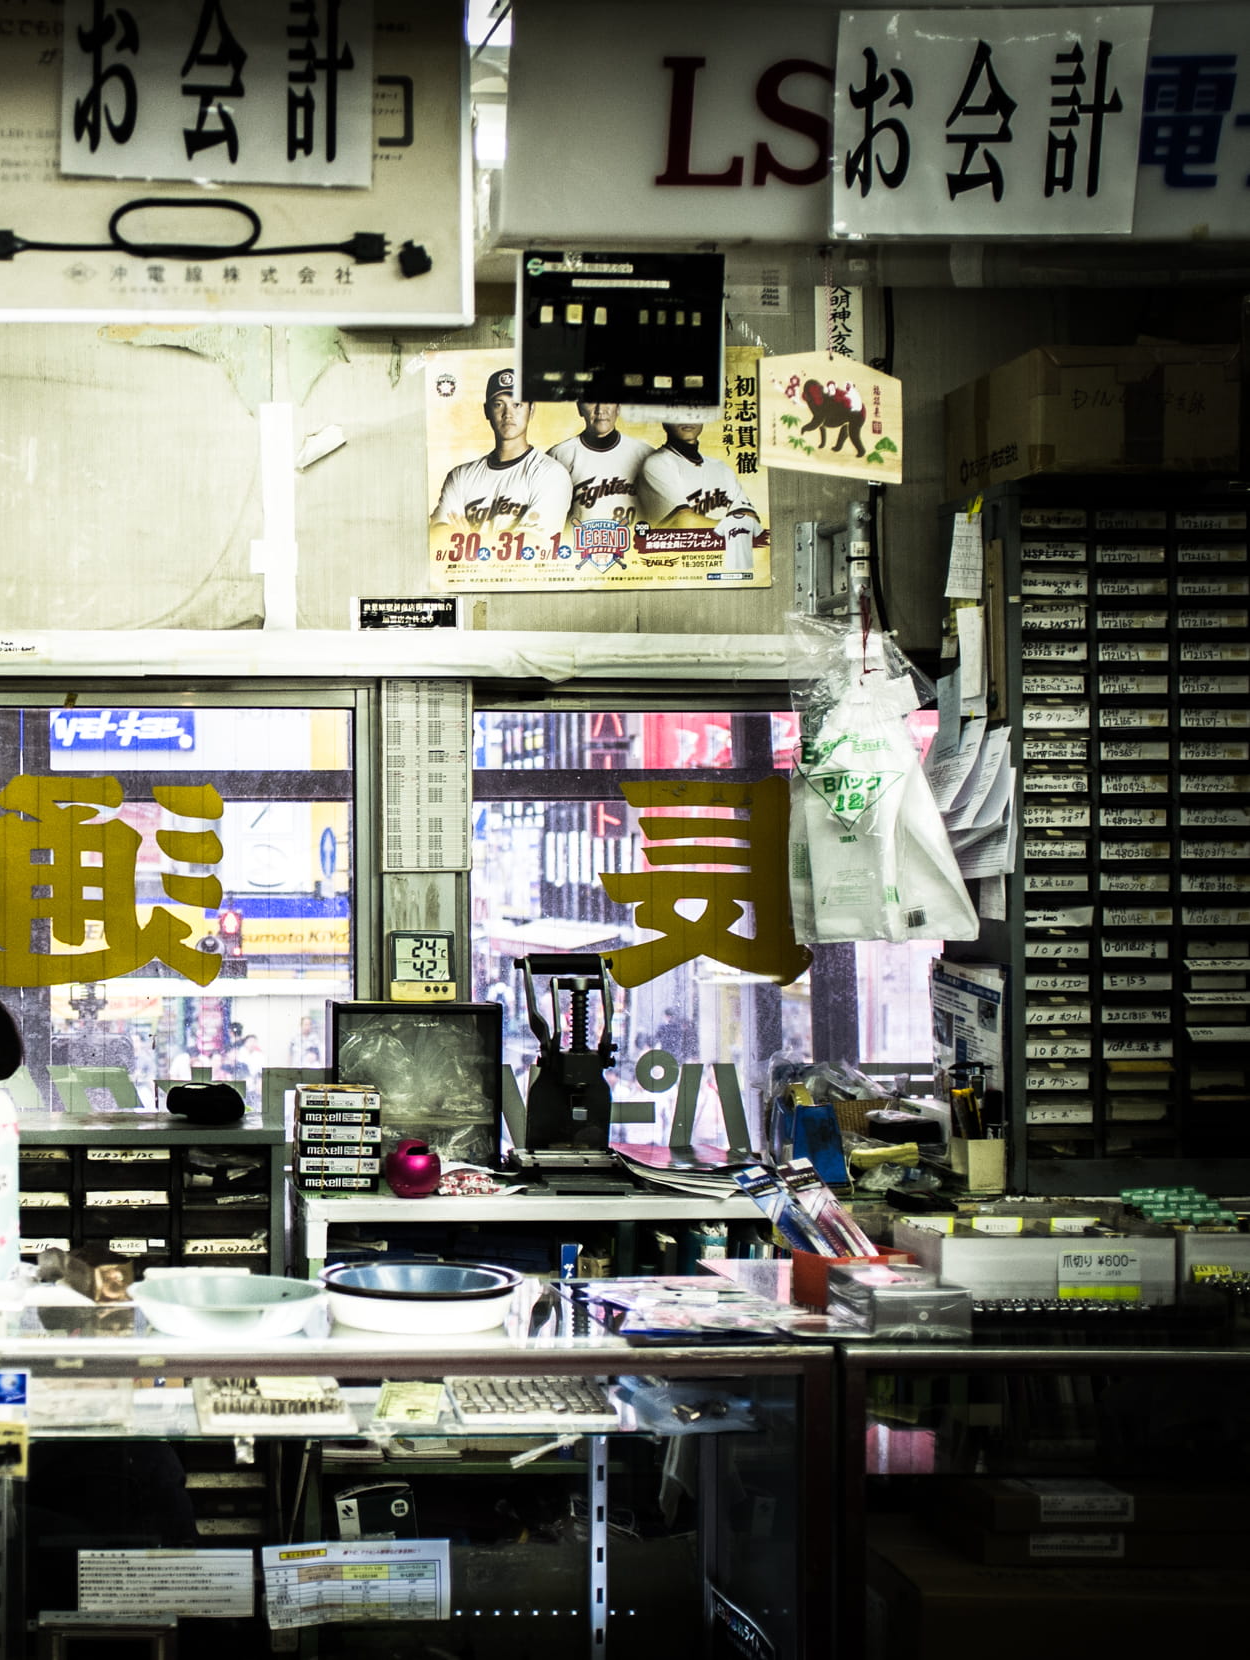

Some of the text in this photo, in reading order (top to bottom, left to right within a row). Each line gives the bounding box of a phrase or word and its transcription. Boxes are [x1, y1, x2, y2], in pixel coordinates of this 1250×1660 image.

[74, 0, 354, 163] お会計
[845, 40, 1122, 201] お会計
[1140, 55, 1250, 188] 電
[110, 265, 354, 285] 沖電線株式会社
[735, 375, 758, 474] 初志貫徹
[575, 528, 630, 551] LEGEND
[823, 774, 881, 794] Bパック
[835, 792, 866, 812] 12
[305, 1112, 341, 1122] maxell
[307, 1145, 343, 1155] maxell
[305, 1178, 341, 1187] maxell
[1063, 1255, 1092, 1268] 爪切り
